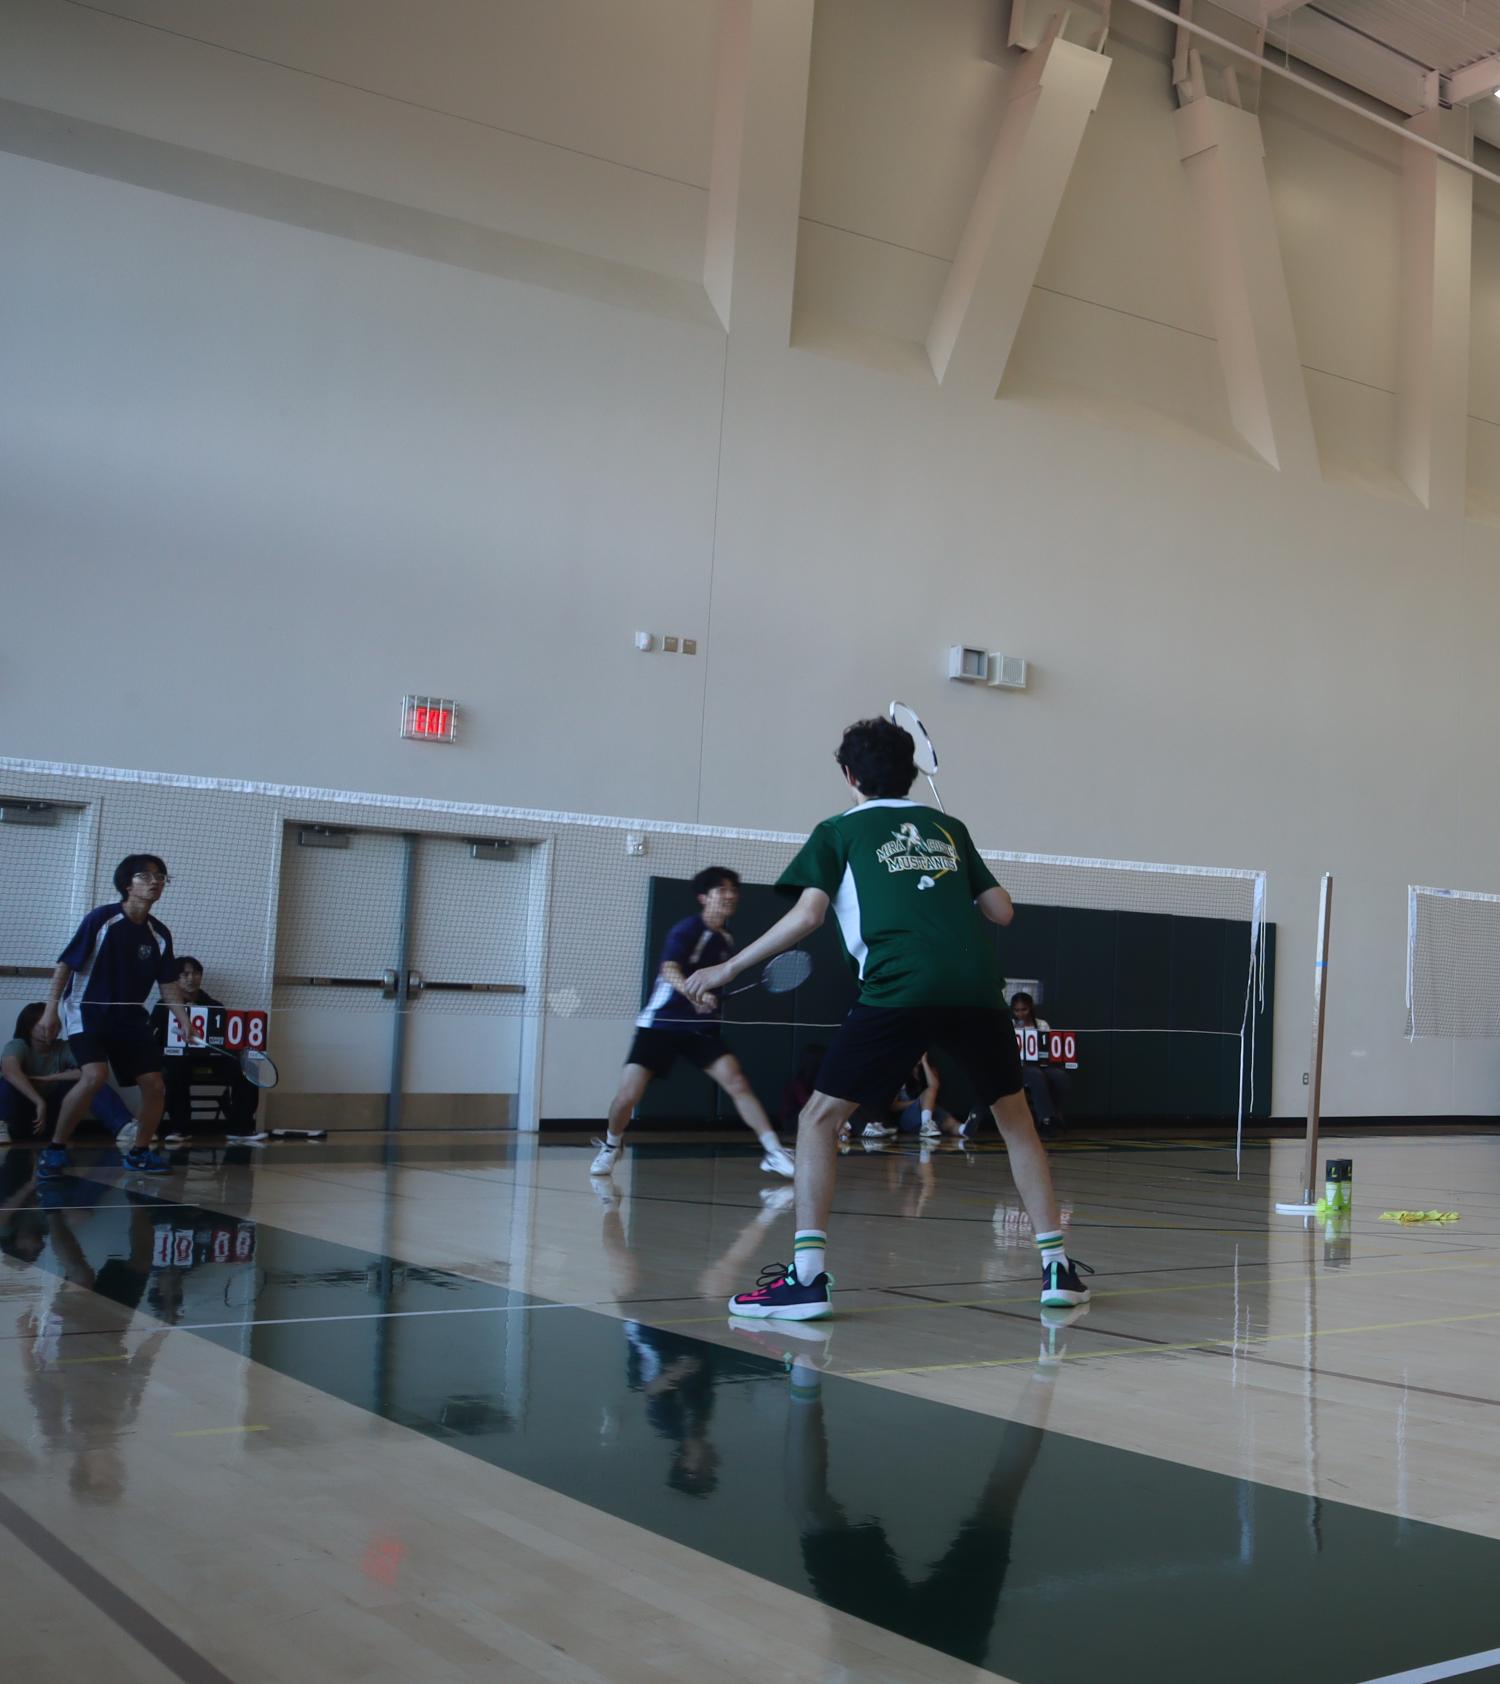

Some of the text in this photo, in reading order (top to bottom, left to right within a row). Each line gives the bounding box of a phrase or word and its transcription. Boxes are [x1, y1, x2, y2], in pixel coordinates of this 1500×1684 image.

[416, 707, 448, 736] EXIT
[876, 839, 906, 863] MIRA
[886, 855, 958, 873] MUSTANGS
[228, 1016, 263, 1046] 08
